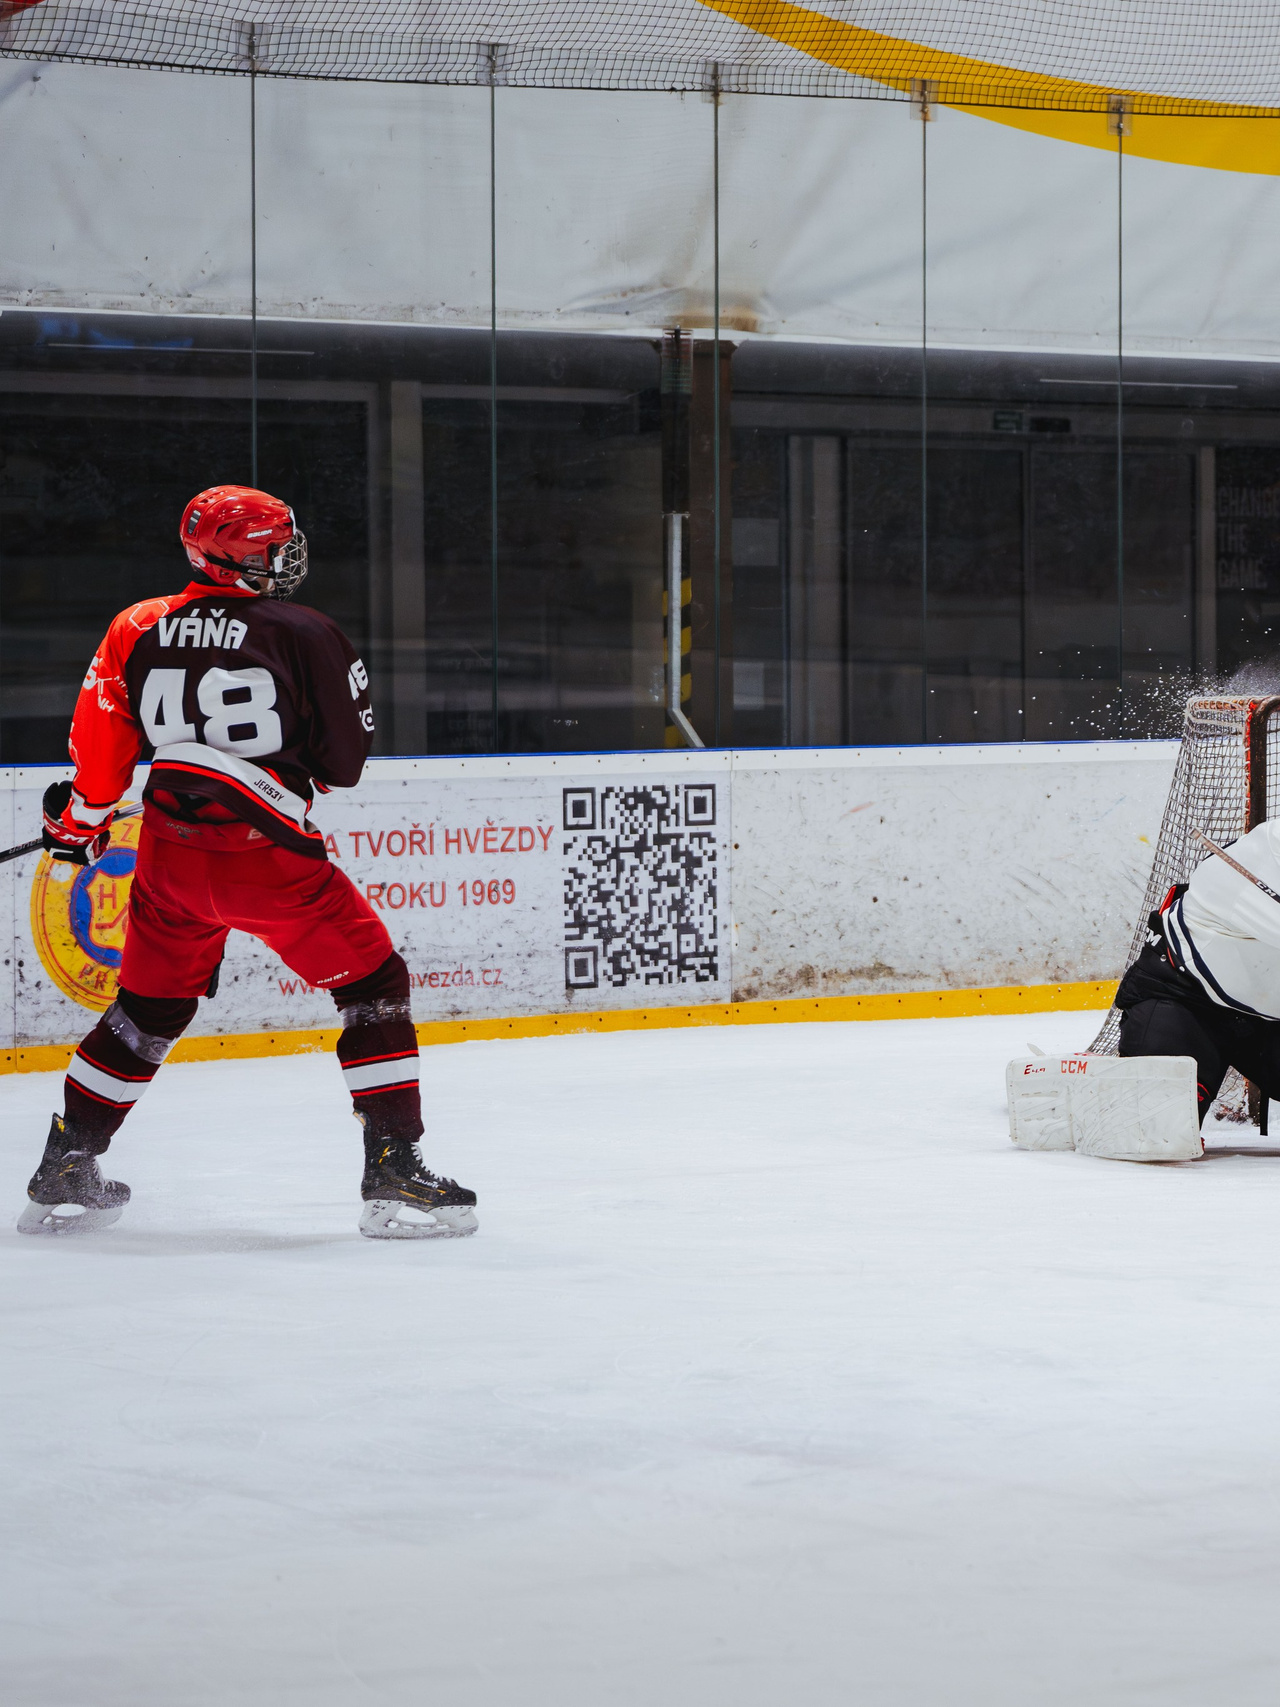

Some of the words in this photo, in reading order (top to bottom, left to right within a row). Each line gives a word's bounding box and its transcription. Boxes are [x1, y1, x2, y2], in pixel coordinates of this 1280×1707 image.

[158, 608, 248, 649] VÁŇA
[139, 667, 283, 758] 48
[349, 822, 434, 858] TVOŘÍ
[445, 820, 554, 855] HVĚZDY
[366, 881, 446, 910] ROKU
[457, 878, 516, 906] 1969
[1061, 1059, 1088, 1074] CCM
